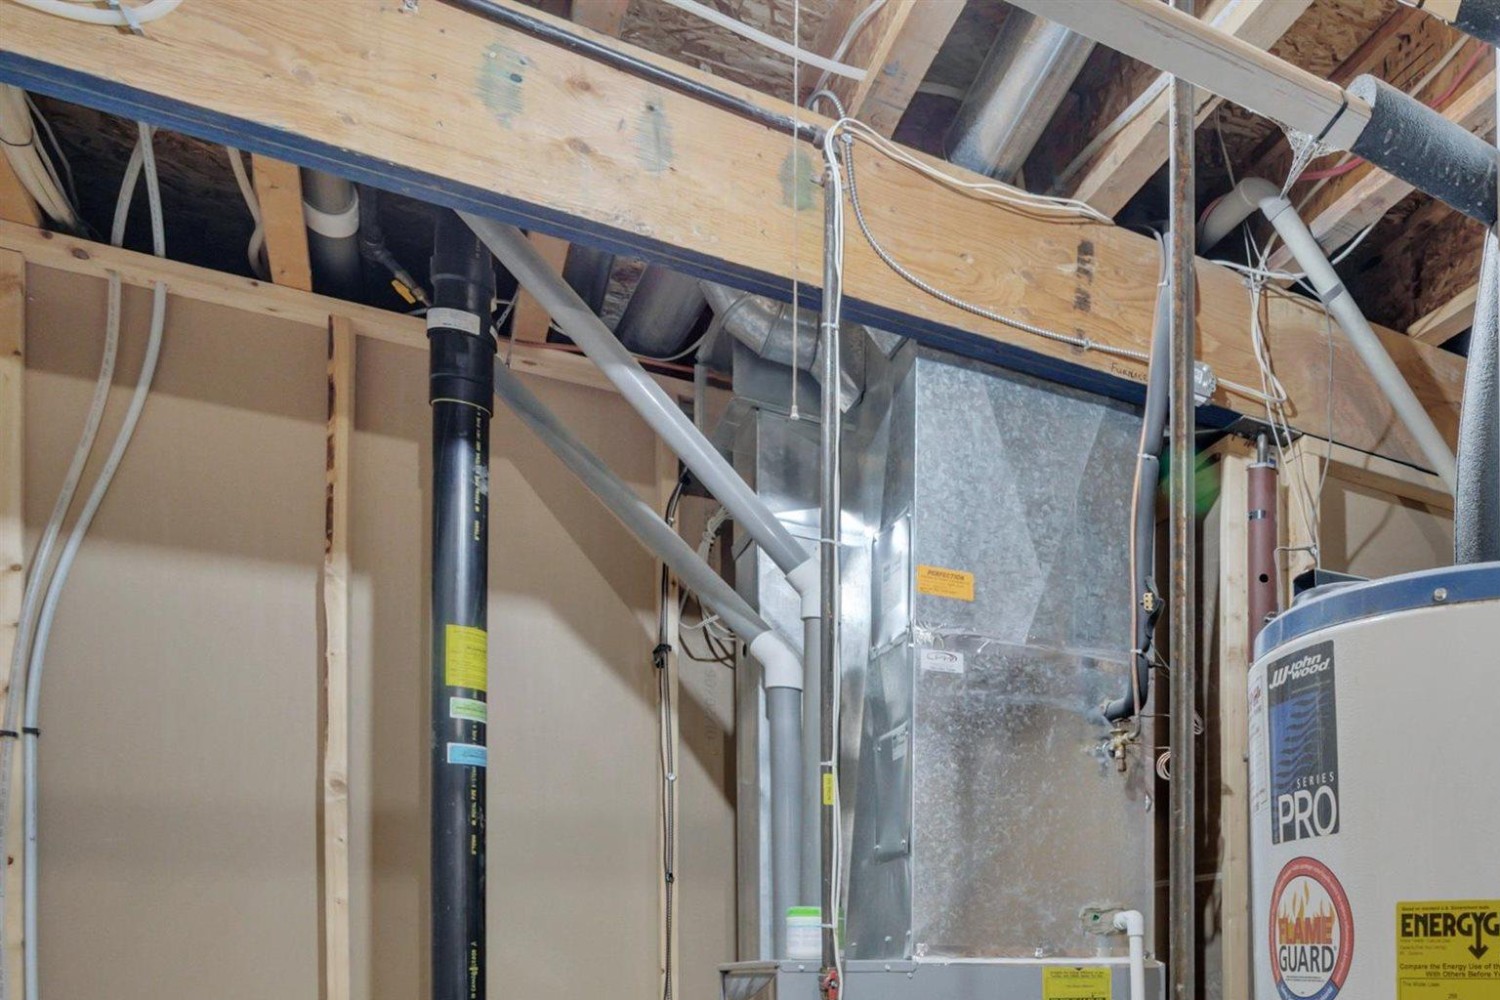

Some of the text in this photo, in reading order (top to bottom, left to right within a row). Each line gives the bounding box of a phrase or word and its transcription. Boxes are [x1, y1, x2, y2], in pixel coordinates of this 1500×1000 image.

[1296, 771, 1335, 787] SERIES
[1278, 785, 1337, 841] PRO
[1277, 915, 1333, 945] FLAME
[1279, 945, 1334, 973] GUARD
[1400, 963, 1428, 971] Compare
[1442, 963, 1466, 971] Energy
